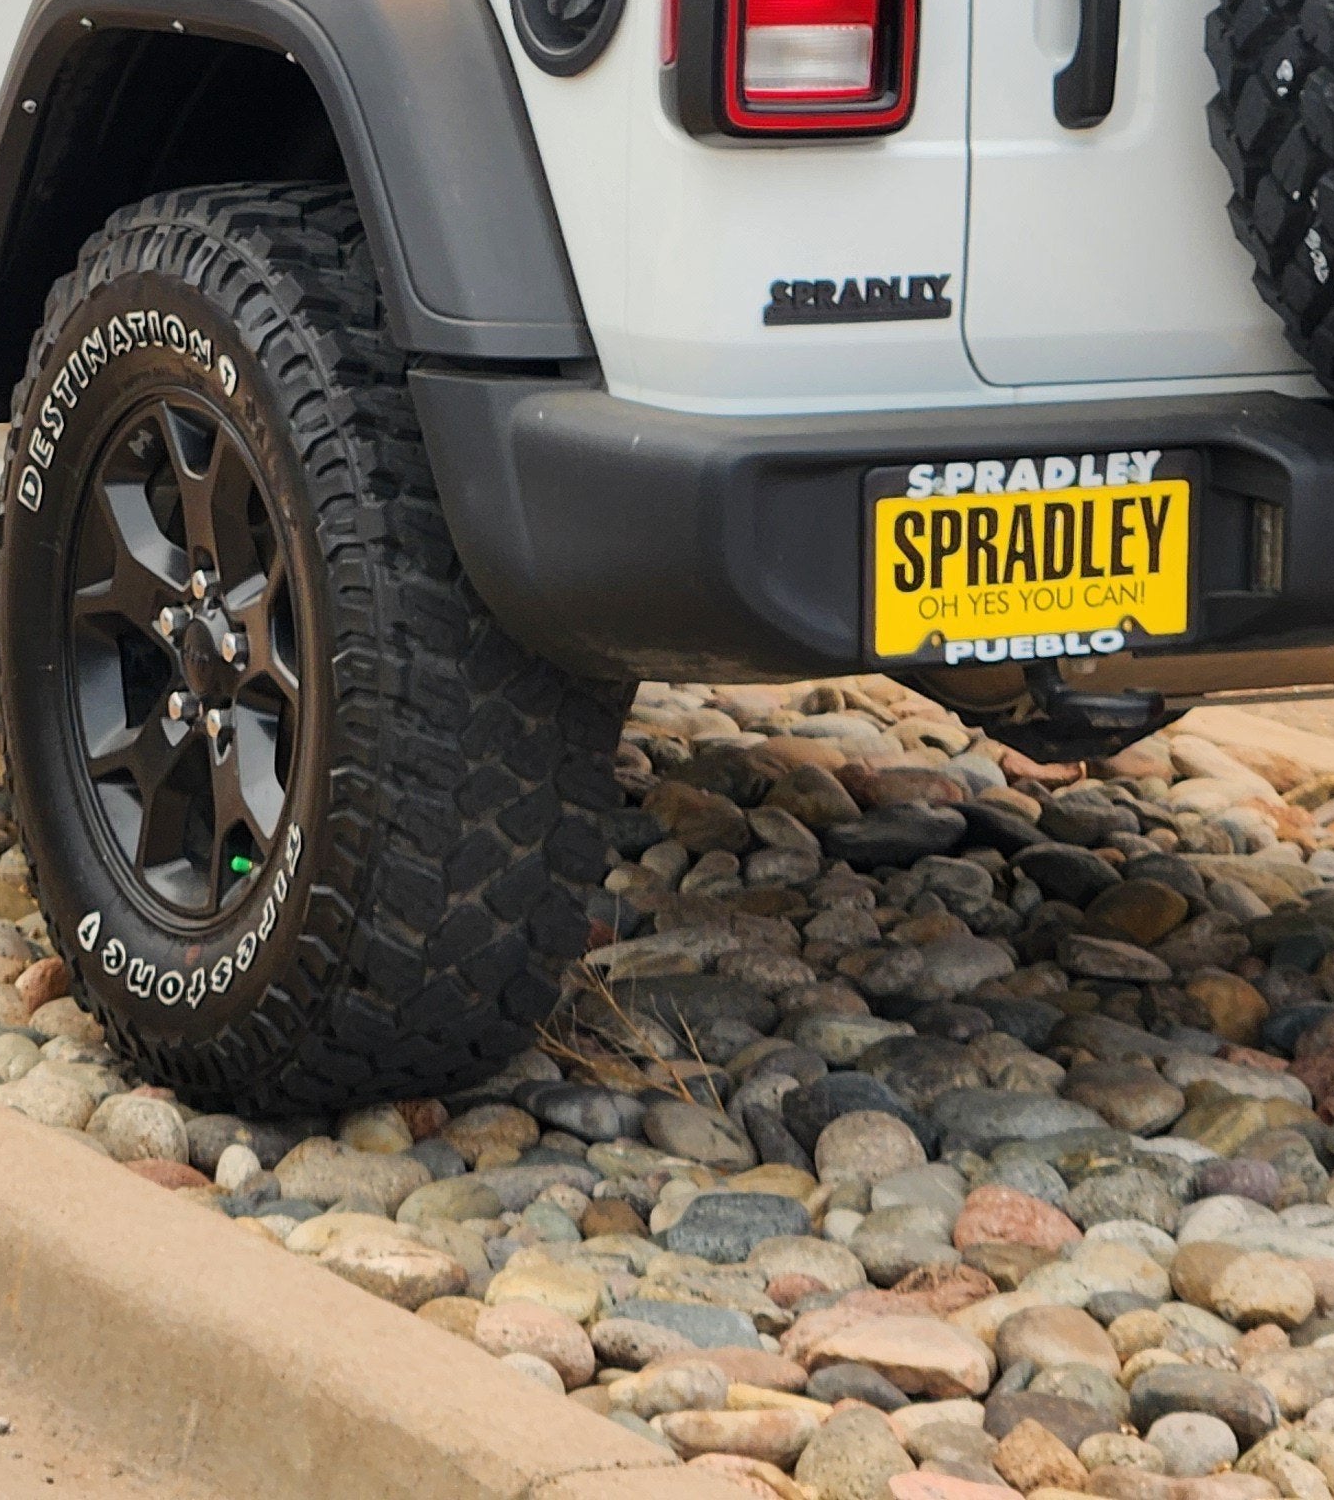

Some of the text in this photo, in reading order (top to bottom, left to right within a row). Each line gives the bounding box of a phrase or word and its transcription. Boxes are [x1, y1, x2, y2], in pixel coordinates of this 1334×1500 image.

[769, 273, 952, 312] SPRADLEY
[17, 309, 213, 513] DESTINATION
[905, 449, 1162, 499] SPRADLEY
[893, 494, 1172, 593] SPRADLEY
[918, 580, 1145, 620] OH YES YOU CAN!
[944, 628, 1126, 665] PUEBLO
[101, 821, 302, 1010] Firestone
